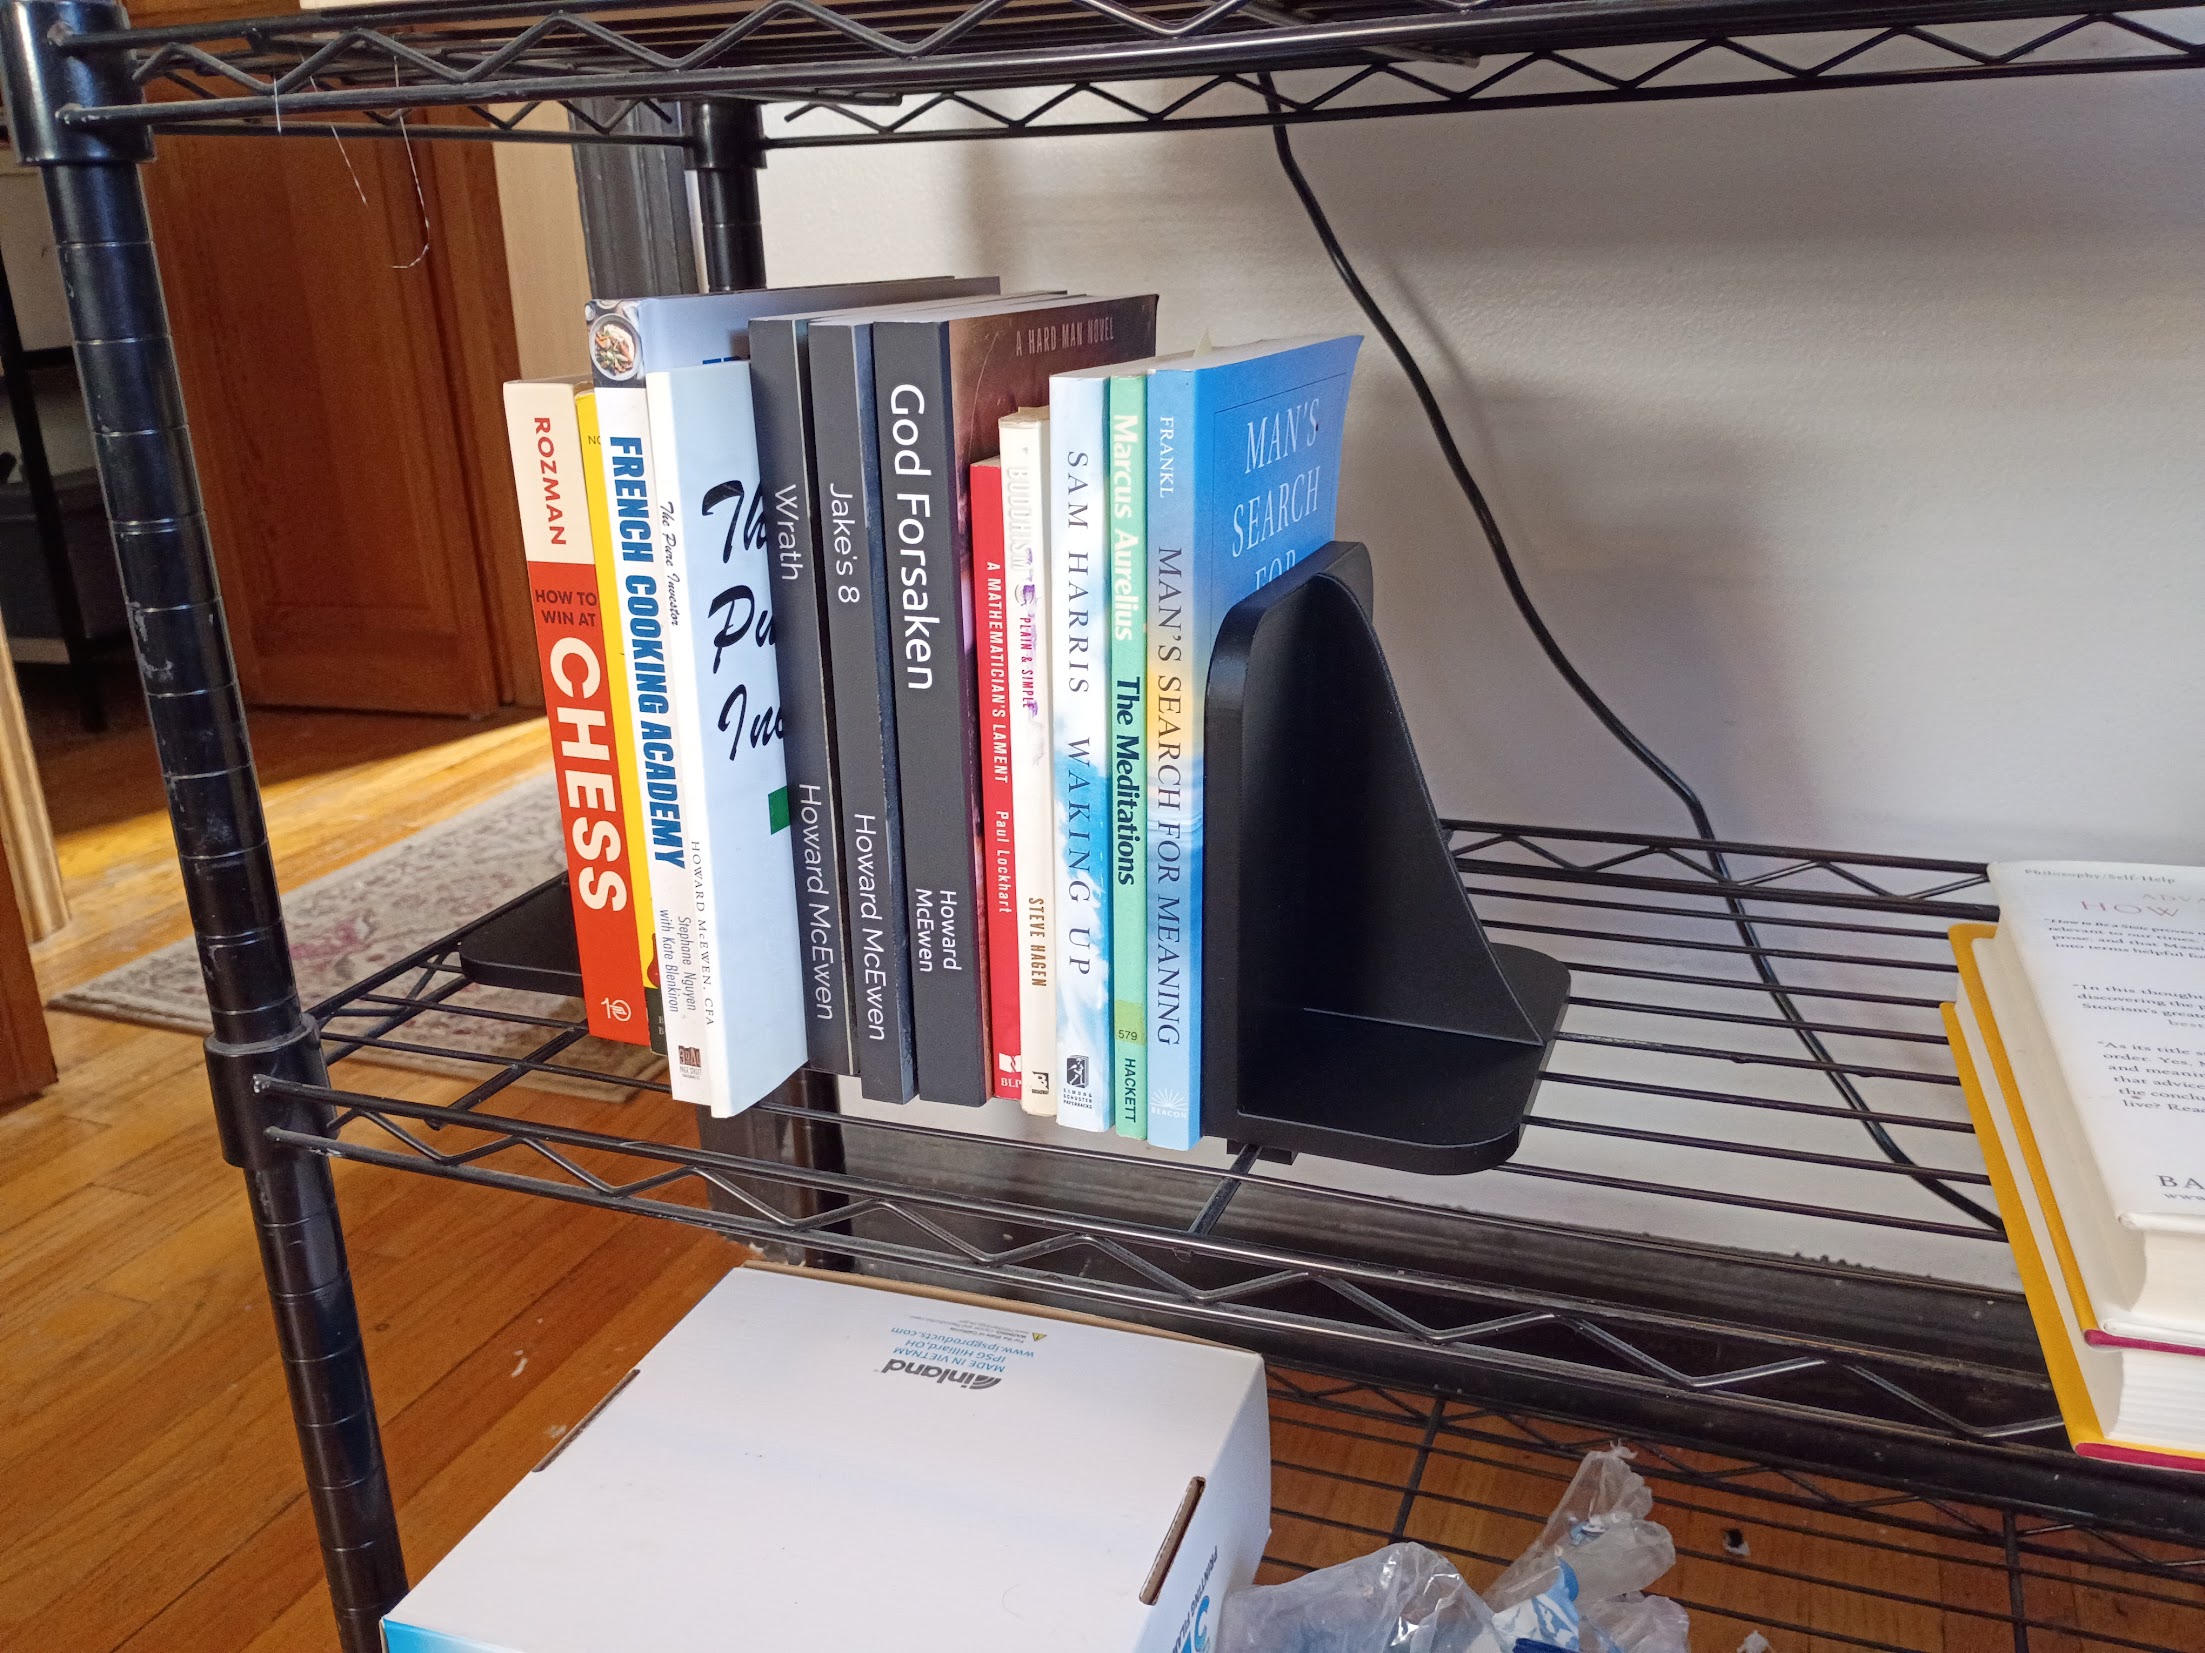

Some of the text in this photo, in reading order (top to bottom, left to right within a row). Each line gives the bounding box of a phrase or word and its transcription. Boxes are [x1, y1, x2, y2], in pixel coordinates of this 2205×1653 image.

[1016, 316, 1114, 357] A HARD MAN NOVEL
[1159, 416, 1175, 499] FRANKL
[1244, 398, 1320, 475] MAN'S
[534, 417, 567, 545] ROZMAN
[1232, 465, 1321, 558] SEARCH
[660, 500, 681, 626] The Pure Investor
[774, 483, 804, 582] Wrath
[829, 483, 860, 604] Jake's 8
[890, 383, 941, 690] God Forsaken
[1112, 414, 1139, 641] Marcus Aurelius
[534, 589, 598, 607] HOW TO
[1067, 451, 1090, 694] SAM HARRIS
[541, 609, 597, 627] WIN AT
[609, 436, 686, 870] FRENCH COOKING ACADEMY
[1019, 617, 1033, 651] PLAIN
[986, 561, 1009, 784] A MATHEMATICIAN'S LAMENT
[1021, 667, 1037, 709] SIMPLE
[549, 636, 628, 912] CHESS
[1116, 676, 1141, 886] The Meditations
[1156, 545, 1182, 1047] MAN'S SEARCH FOR MEANING
[995, 810, 1013, 914] Paul Lockhart
[1067, 736, 1091, 975] WAKING UP
[691, 840, 705, 913] HOWARD
[703, 996, 715, 1027] CFA
[799, 783, 834, 1021] Howard McEwen
[854, 813, 887, 1042] Howard McEwen
[915, 887, 935, 974] McEwen
[939, 889, 963, 972] Howard
[1028, 897, 1047, 987] STEVE HAGEN
[2049, 926, 2103, 934] relevant
[2081, 900, 2179, 917] HOW
[659, 909, 682, 1013] with Kate Blenkiron
[677, 916, 697, 1011] Stephane Nguyen
[2133, 947, 2183, 957] helpful
[1118, 1028, 1138, 1041] 579
[2077, 993, 2166, 1007] discovering
[2169, 1000, 2193, 1008] the
[2082, 1003, 2158, 1015] Stoicism's
[1124, 1057, 1137, 1123] HACKETT
[2108, 1065, 2139, 1073] and
[2113, 1075, 2147, 1085] that
[2118, 1087, 2146, 1097] the
[2157, 1047, 2190, 1055] title
[1151, 1106, 1187, 1119] BEACON
[880, 1358, 975, 1389] inland
[891, 1327, 1034, 1359] www.ipsgproducts.com
[892, 1346, 1006, 1373] MADE IN VIETNAM
[975, 1351, 1006, 1364] IPSG
